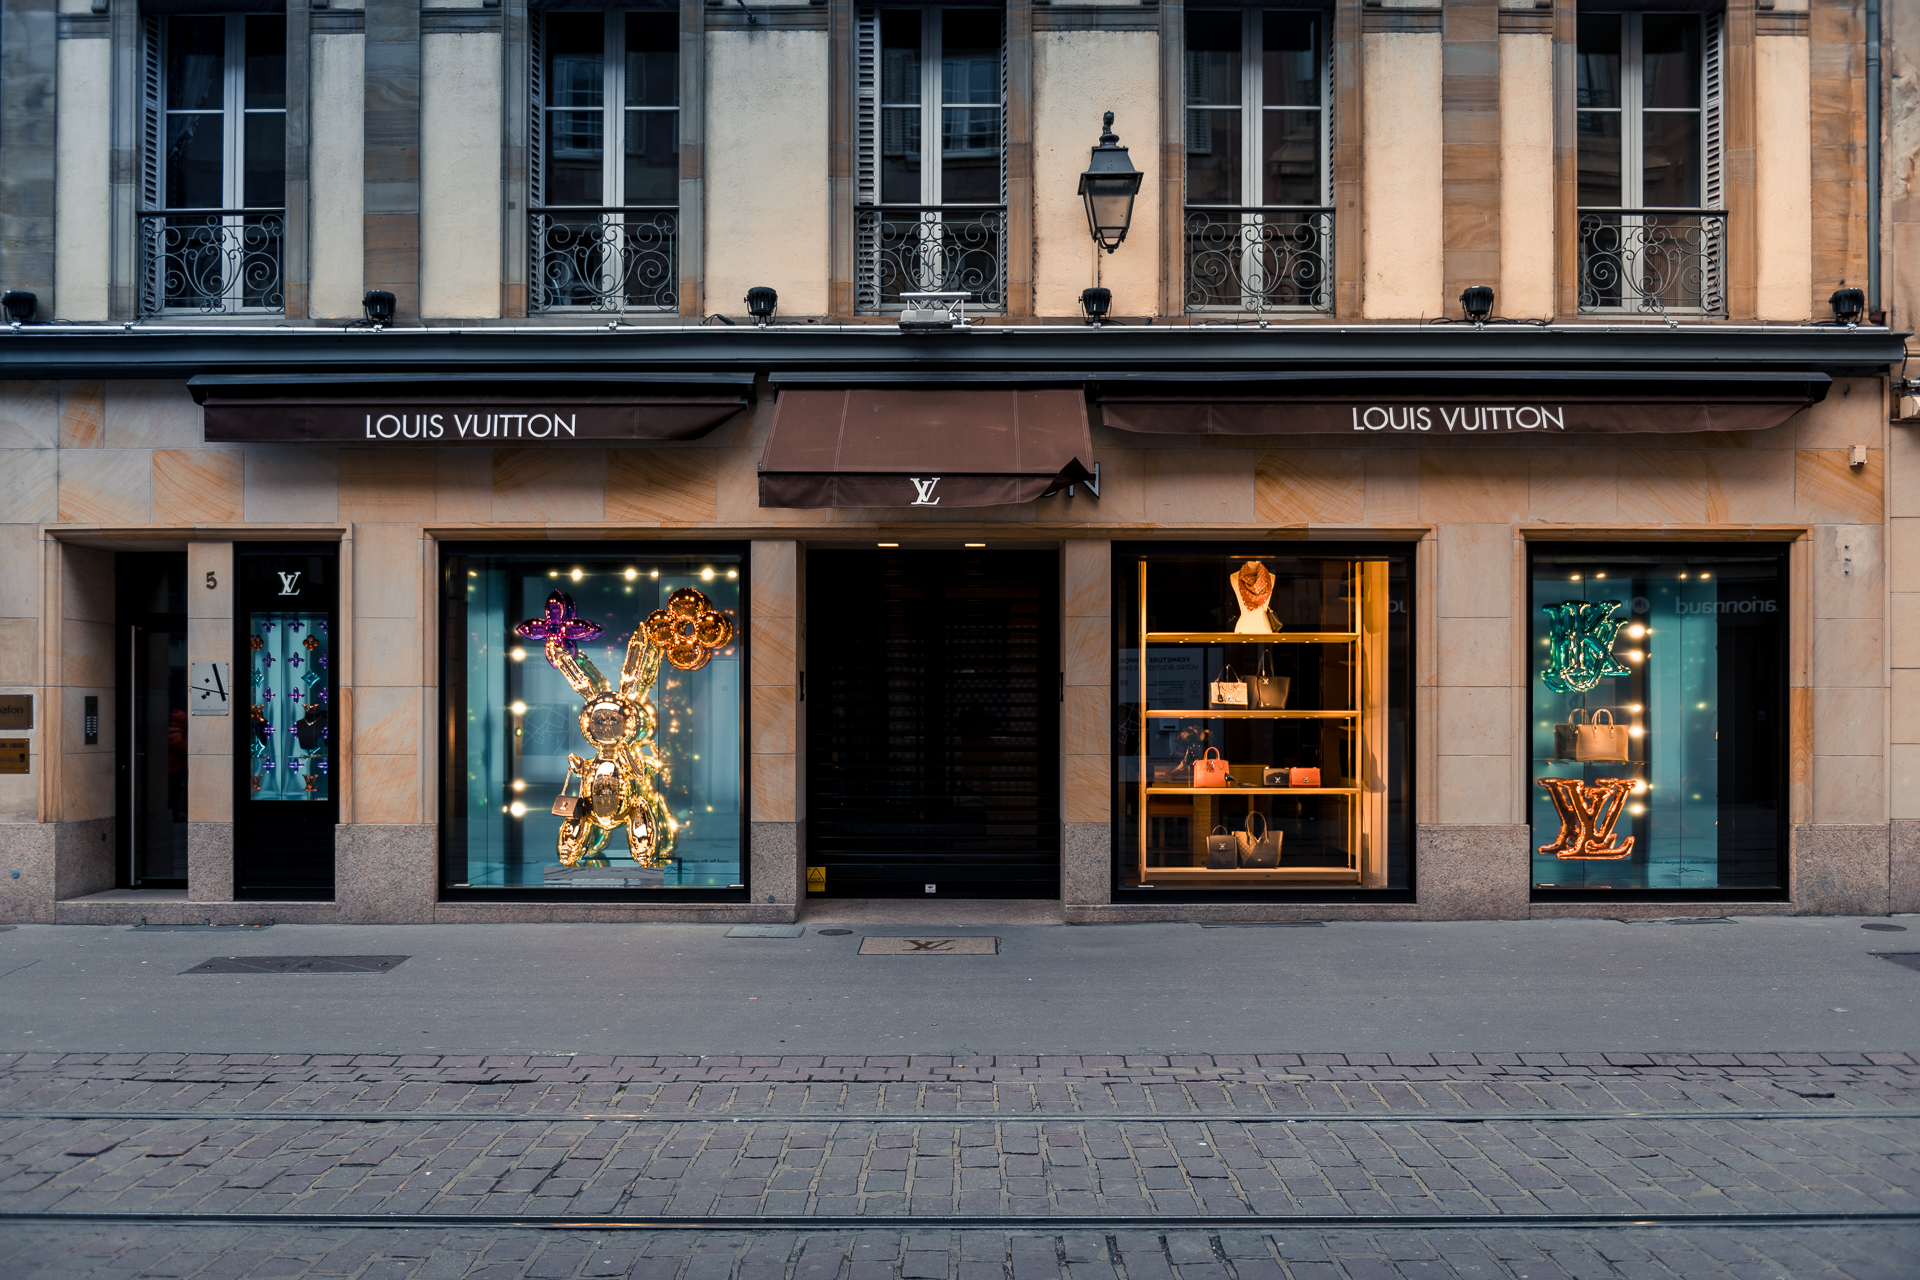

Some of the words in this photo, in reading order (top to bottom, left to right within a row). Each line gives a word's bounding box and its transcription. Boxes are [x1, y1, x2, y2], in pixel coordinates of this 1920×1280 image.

[366, 413, 444, 439] LOUIS
[453, 413, 576, 438] VUITTON
[1352, 406, 1432, 432] LOUIS
[1439, 406, 1565, 432] VUITTON
[206, 571, 218, 590] 5
